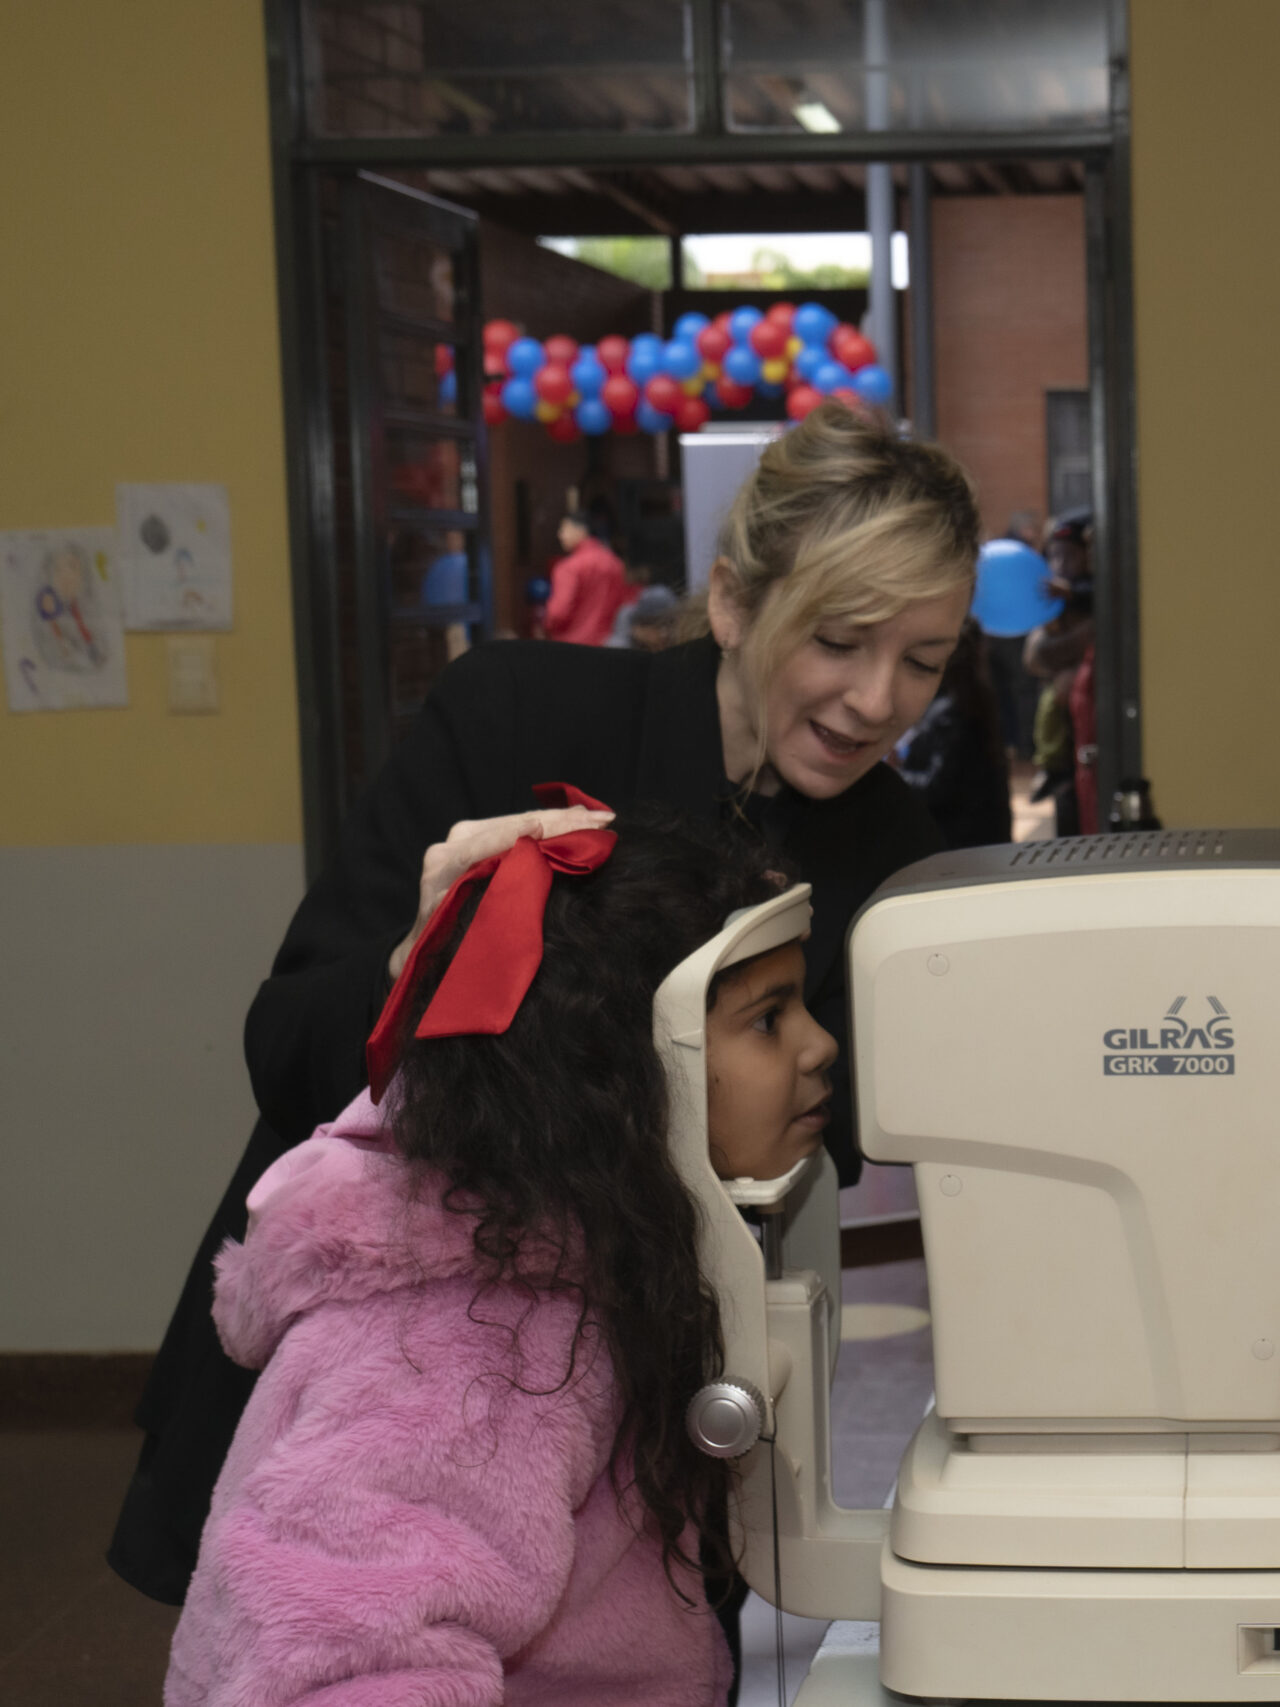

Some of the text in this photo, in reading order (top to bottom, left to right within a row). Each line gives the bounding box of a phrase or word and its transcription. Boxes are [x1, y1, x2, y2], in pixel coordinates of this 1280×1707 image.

[1103, 1028, 1235, 1050] GILRAS
[1109, 1057, 1229, 1074] GRK 7000
